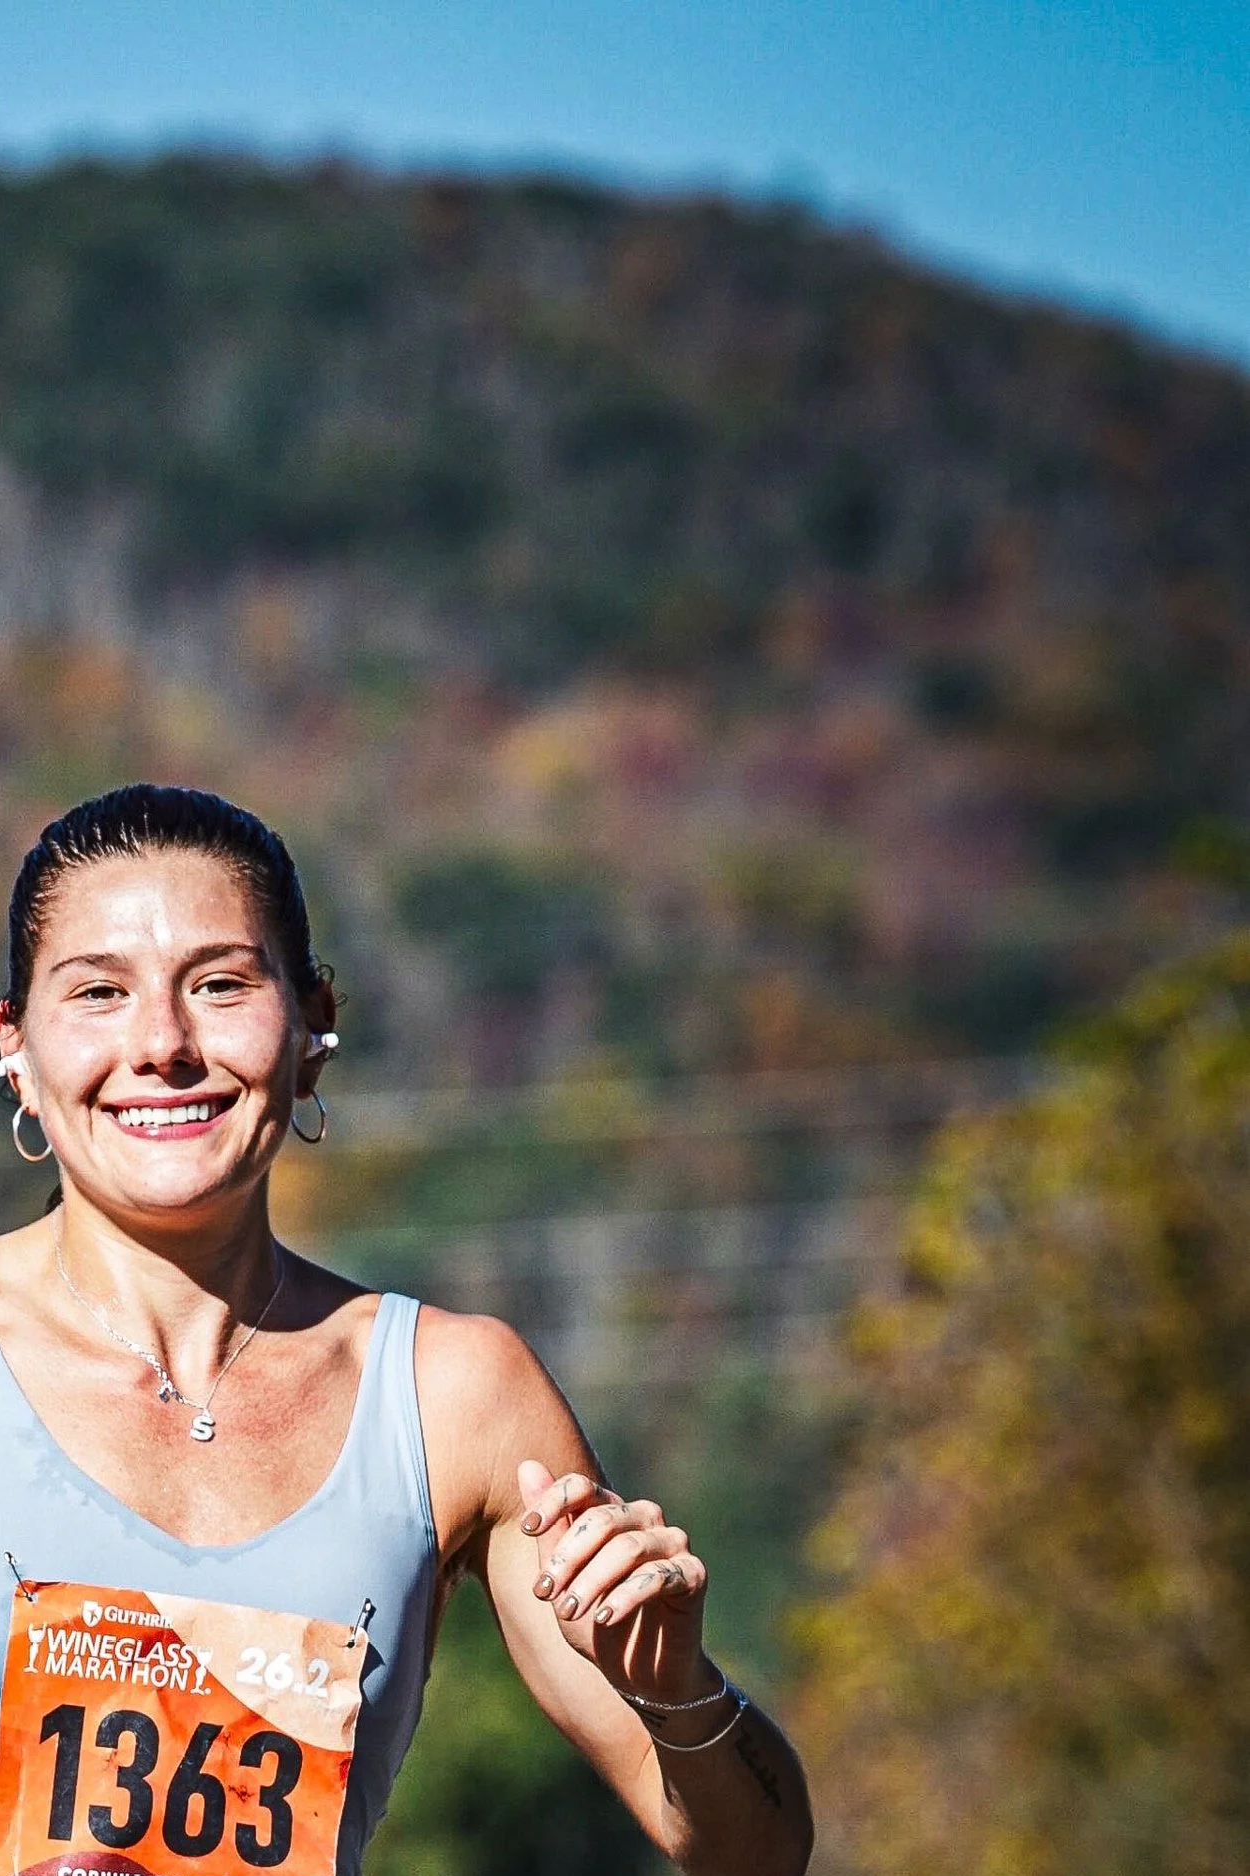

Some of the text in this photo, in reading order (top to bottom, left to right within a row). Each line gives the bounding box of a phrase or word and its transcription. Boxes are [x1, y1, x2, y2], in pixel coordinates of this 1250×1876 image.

[190, 1413, 216, 1443] S
[47, 1628, 193, 1670] WINEGLASS
[44, 1652, 188, 1691] MARATHON
[235, 1647, 330, 1699] 26.2
[38, 1703, 303, 1868] 1363
